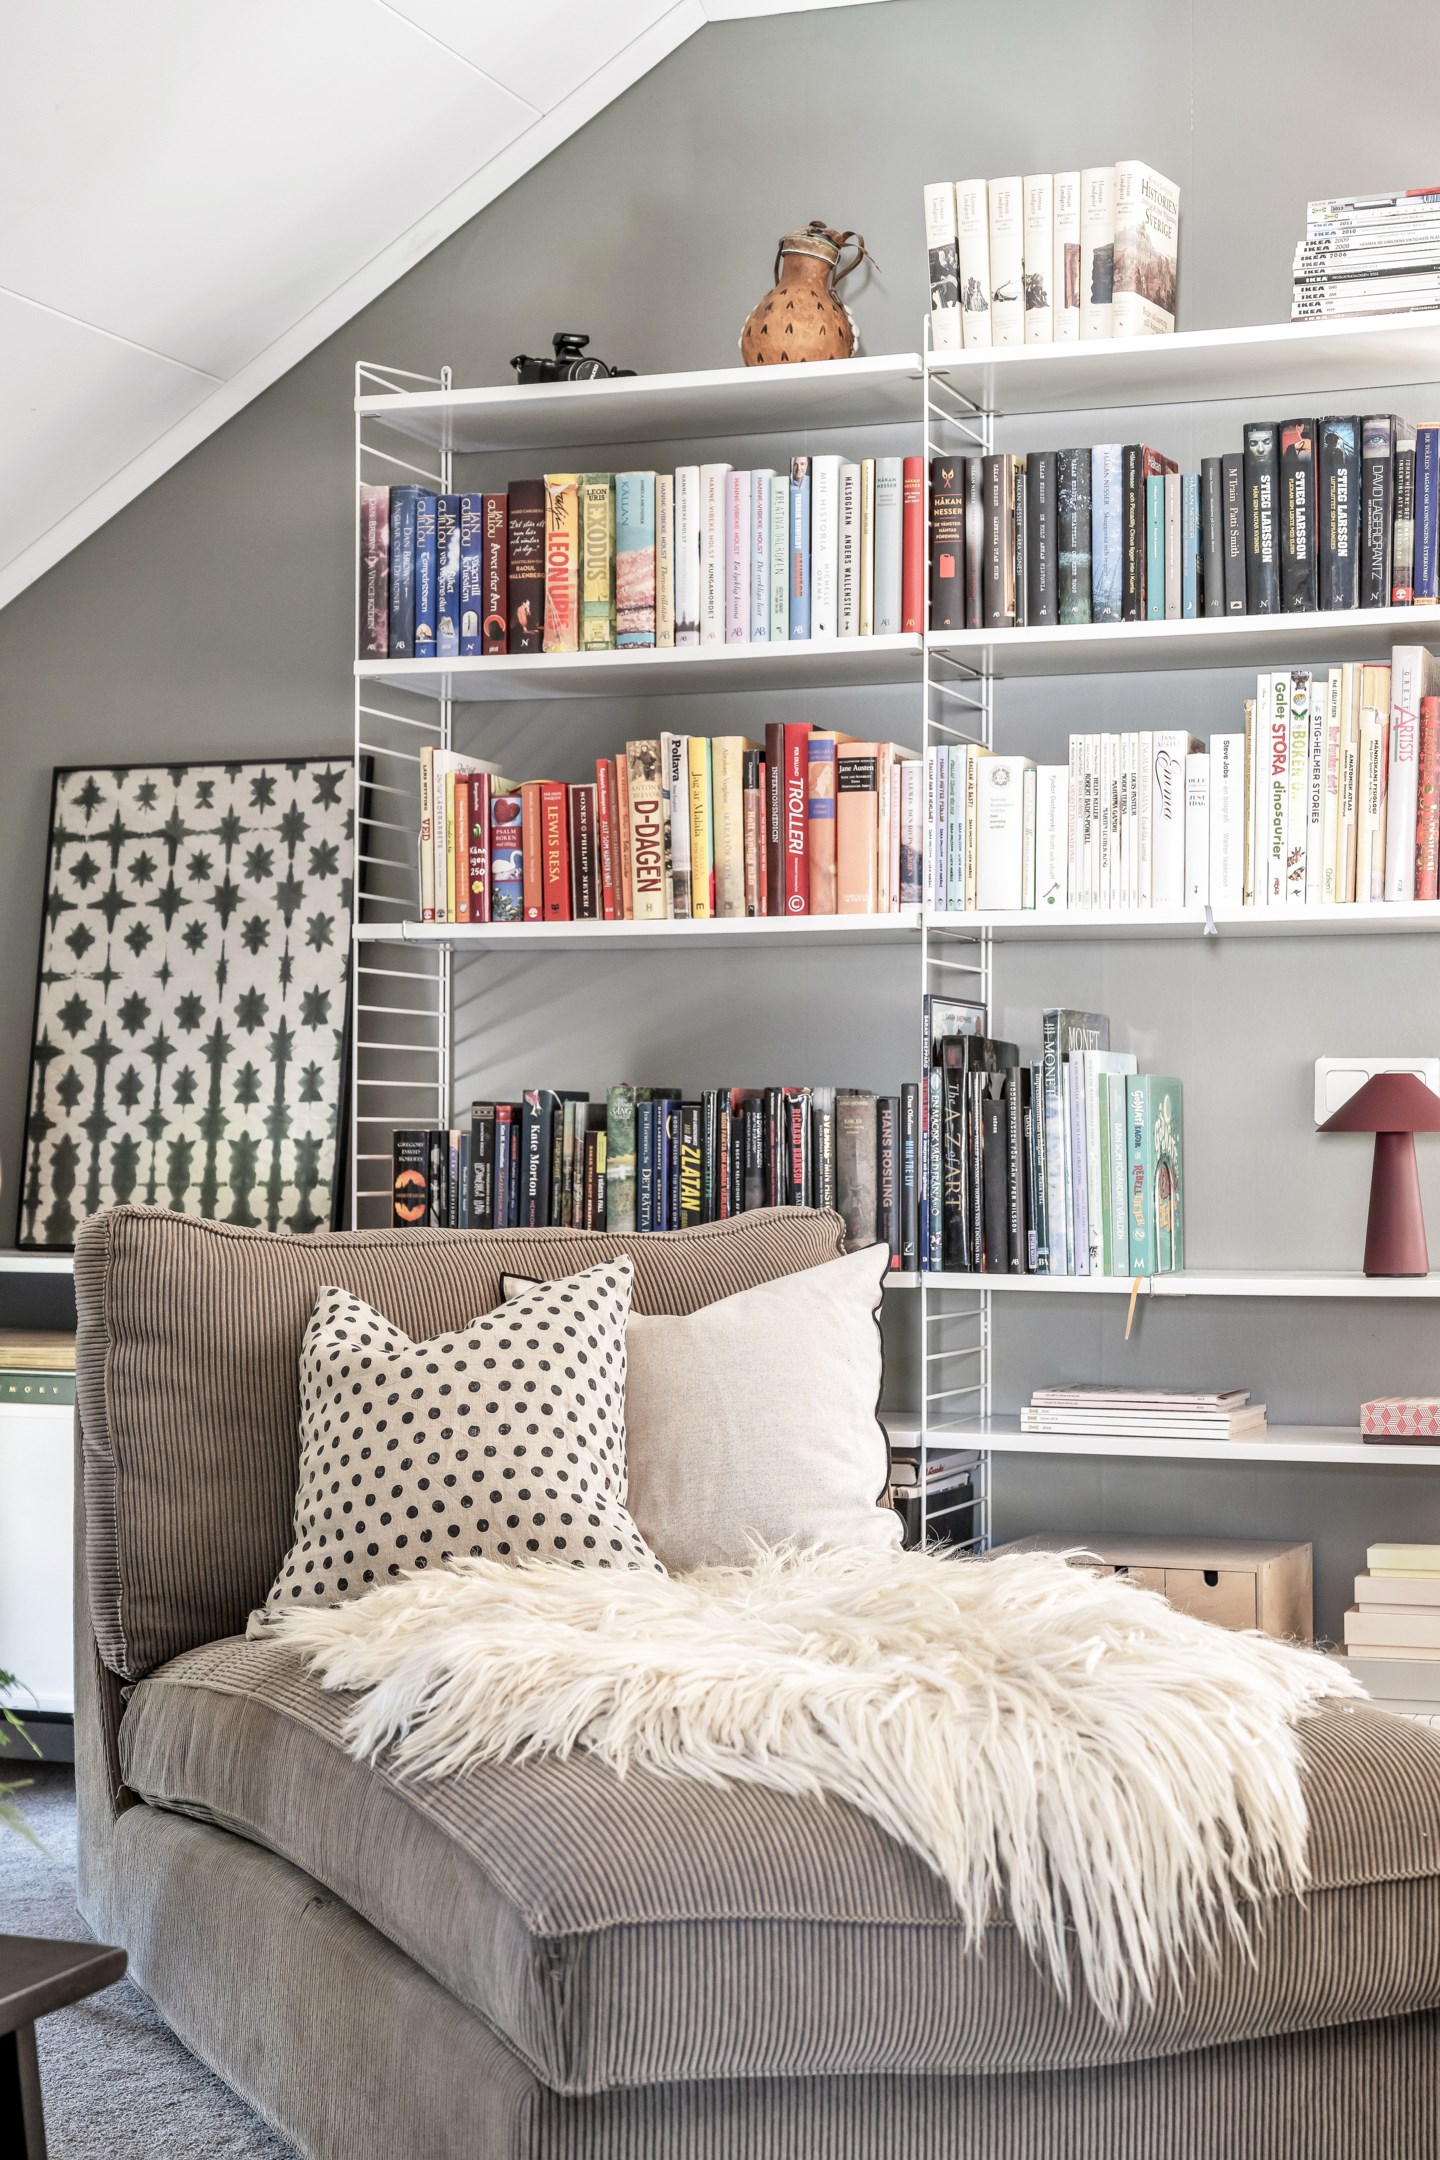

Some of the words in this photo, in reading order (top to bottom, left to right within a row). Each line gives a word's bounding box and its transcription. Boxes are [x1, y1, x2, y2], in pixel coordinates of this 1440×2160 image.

[1103, 452, 1111, 479] HÅKAN
[1228, 468, 1238, 477] M
[1372, 464, 1384, 497] DAVID
[586, 488, 607, 496] LEON
[819, 472, 827, 493] MIN
[1229, 480, 1238, 502] Train
[1260, 474, 1271, 510] STIEG
[1295, 471, 1306, 506] STIEG
[1337, 468, 1348, 503] STIEG
[621, 481, 630, 526] KÄLLAN
[844, 476, 854, 526] HÄLSOGÅTAN
[933, 507, 963, 516] NESSER
[934, 496, 962, 506] HÅKAN
[1230, 506, 1239, 528] Patti
[394, 500, 403, 538] ÄNGLAR
[416, 500, 426, 548] GUILLOU
[426, 514, 435, 535] JAN
[436, 500, 447, 550] GUILLOU
[446, 514, 456, 535] JAN
[461, 498, 471, 547] GUILLOU
[470, 512, 481, 533] JAN
[487, 499, 496, 539] GUILLOU
[494, 510, 504, 528] JAN
[819, 498, 828, 552] HISTORIA
[1102, 512, 1110, 543] Skuggorna
[1295, 507, 1306, 560] LARSSON
[1337, 504, 1348, 557] LARSSON
[402, 527, 412, 548] DAN
[586, 502, 607, 581] EXODUS
[844, 534, 852, 564] ANDERS
[935, 532, 960, 540] FÖRENING
[1230, 529, 1240, 558] Smith
[1260, 511, 1272, 563] LARSSON
[1371, 498, 1383, 580] LAGERCRANTZ
[394, 544, 402, 562] OCH
[402, 550, 412, 585] BROWN
[470, 554, 480, 583] Vägen
[490, 542, 501, 570] Arvet
[733, 560, 740, 571] En
[1102, 557, 1110, 576] regnet
[393, 564, 402, 612] DEMONER
[420, 551, 430, 613] Tempelriddaren
[460, 554, 471, 602] Jerusalem
[471, 582, 480, 596] till
[490, 570, 500, 592] efter
[707, 563, 715, 620] KUNGAMORDET
[732, 573, 741, 595] lycklig
[843, 567, 851, 617] WALLENSTEN
[490, 592, 501, 612] Arn
[733, 596, 741, 620] kvinna
[1274, 682, 1287, 720] Galet
[1271, 722, 1288, 776] STORA
[1312, 715, 1322, 781] STIG-HELMER
[1393, 704, 1419, 762] ARTISTS
[671, 739, 682, 782] Poltava
[838, 764, 852, 774] Jane
[853, 764, 874, 772] Austen
[1291, 730, 1306, 777] BOKEN
[1372, 739, 1380, 782] MÄNNISKANS
[692, 771, 703, 789] Jag
[693, 790, 702, 801] är
[1155, 750, 1182, 821] Emma
[693, 803, 704, 837] Malala
[746, 810, 756, 830] Helt
[788, 777, 804, 855] TROLLERI
[1222, 796, 1230, 824] biografi
[1272, 780, 1286, 860] dinosaurier
[1311, 783, 1321, 824] STORIES
[422, 818, 431, 842] VED
[547, 805, 559, 846] LEWIS
[469, 847, 487, 856] Känn
[470, 856, 487, 866] igen
[580, 833, 588, 873] PHILIPP
[634, 800, 662, 893] D-DAGEN
[745, 830, 755, 865] vanliga
[470, 867, 486, 877] 250
[548, 850, 560, 883] RESA
[748, 866, 756, 886] män
[1068, 1026, 1100, 1052] MONET
[1044, 1040, 1057, 1096] MONET
[948, 1083, 960, 1104] The
[610, 1106, 632, 1116] SÅNG
[792, 1108, 802, 1145] RICHARD
[530, 1124, 541, 1152] Kate
[882, 1109, 893, 1147] HANS
[1114, 1122, 1124, 1143] BARN
[793, 1147, 803, 1184] BRANSON
[904, 1140, 914, 1159] MINA
[946, 1150, 961, 1164] of
[1115, 1144, 1124, 1161] SOM
[528, 1154, 540, 1196] Morton
[641, 1168, 652, 1191] DET
[681, 1144, 701, 1212] ZLATAN
[882, 1149, 893, 1208] ROSLING
[904, 1160, 914, 1174] TRE
[904, 1175, 914, 1187] LIV
[944, 1164, 962, 1211] ART
[1116, 1161, 1126, 1207] FÖRÄNDRAT
[641, 1192, 652, 1226] RÄTTA
[672, 1211, 678, 1222] OM
[1116, 1207, 1125, 1240] VÄRLDEN
[0, 1386, 59, 1394] MORY
